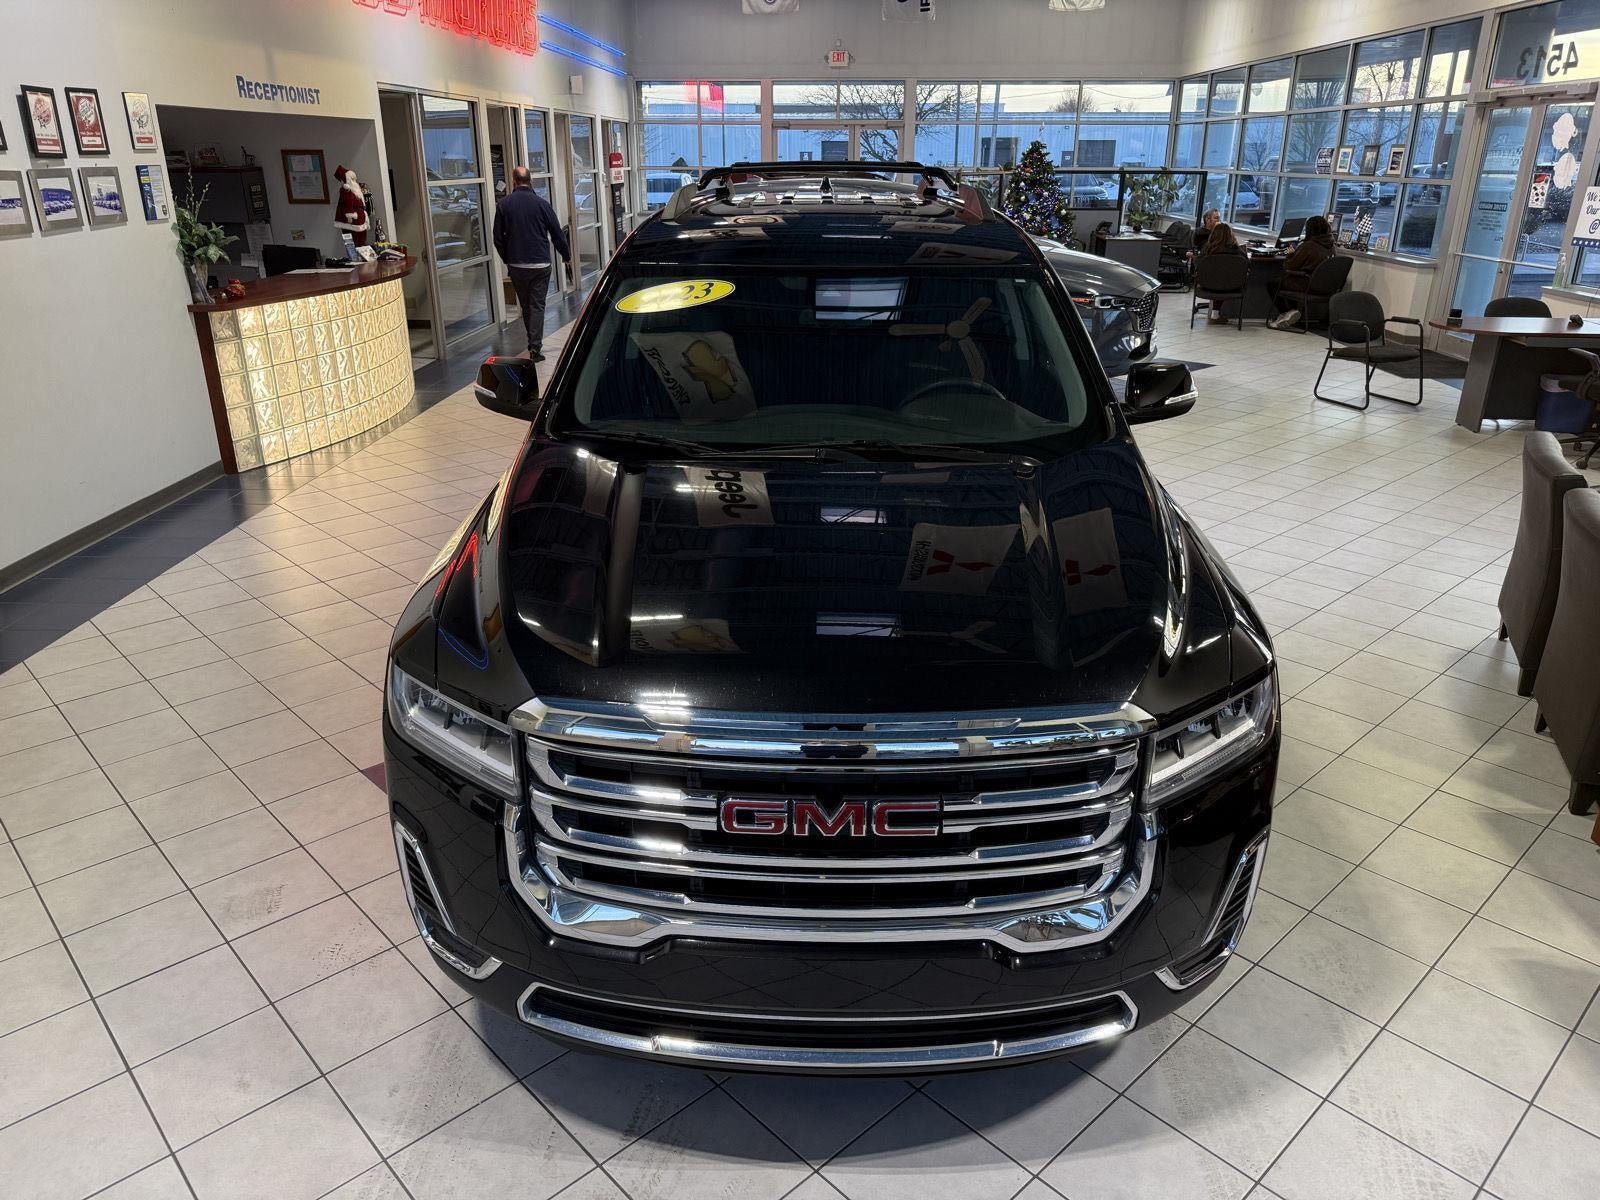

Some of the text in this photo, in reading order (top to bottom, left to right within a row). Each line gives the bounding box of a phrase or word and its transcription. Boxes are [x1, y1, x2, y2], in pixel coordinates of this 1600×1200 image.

[832, 51, 845, 63] EXIT
[235, 75, 321, 104] RECEPTIONIST
[1586, 191, 1598, 202] We
[720, 799, 940, 837] GMC
